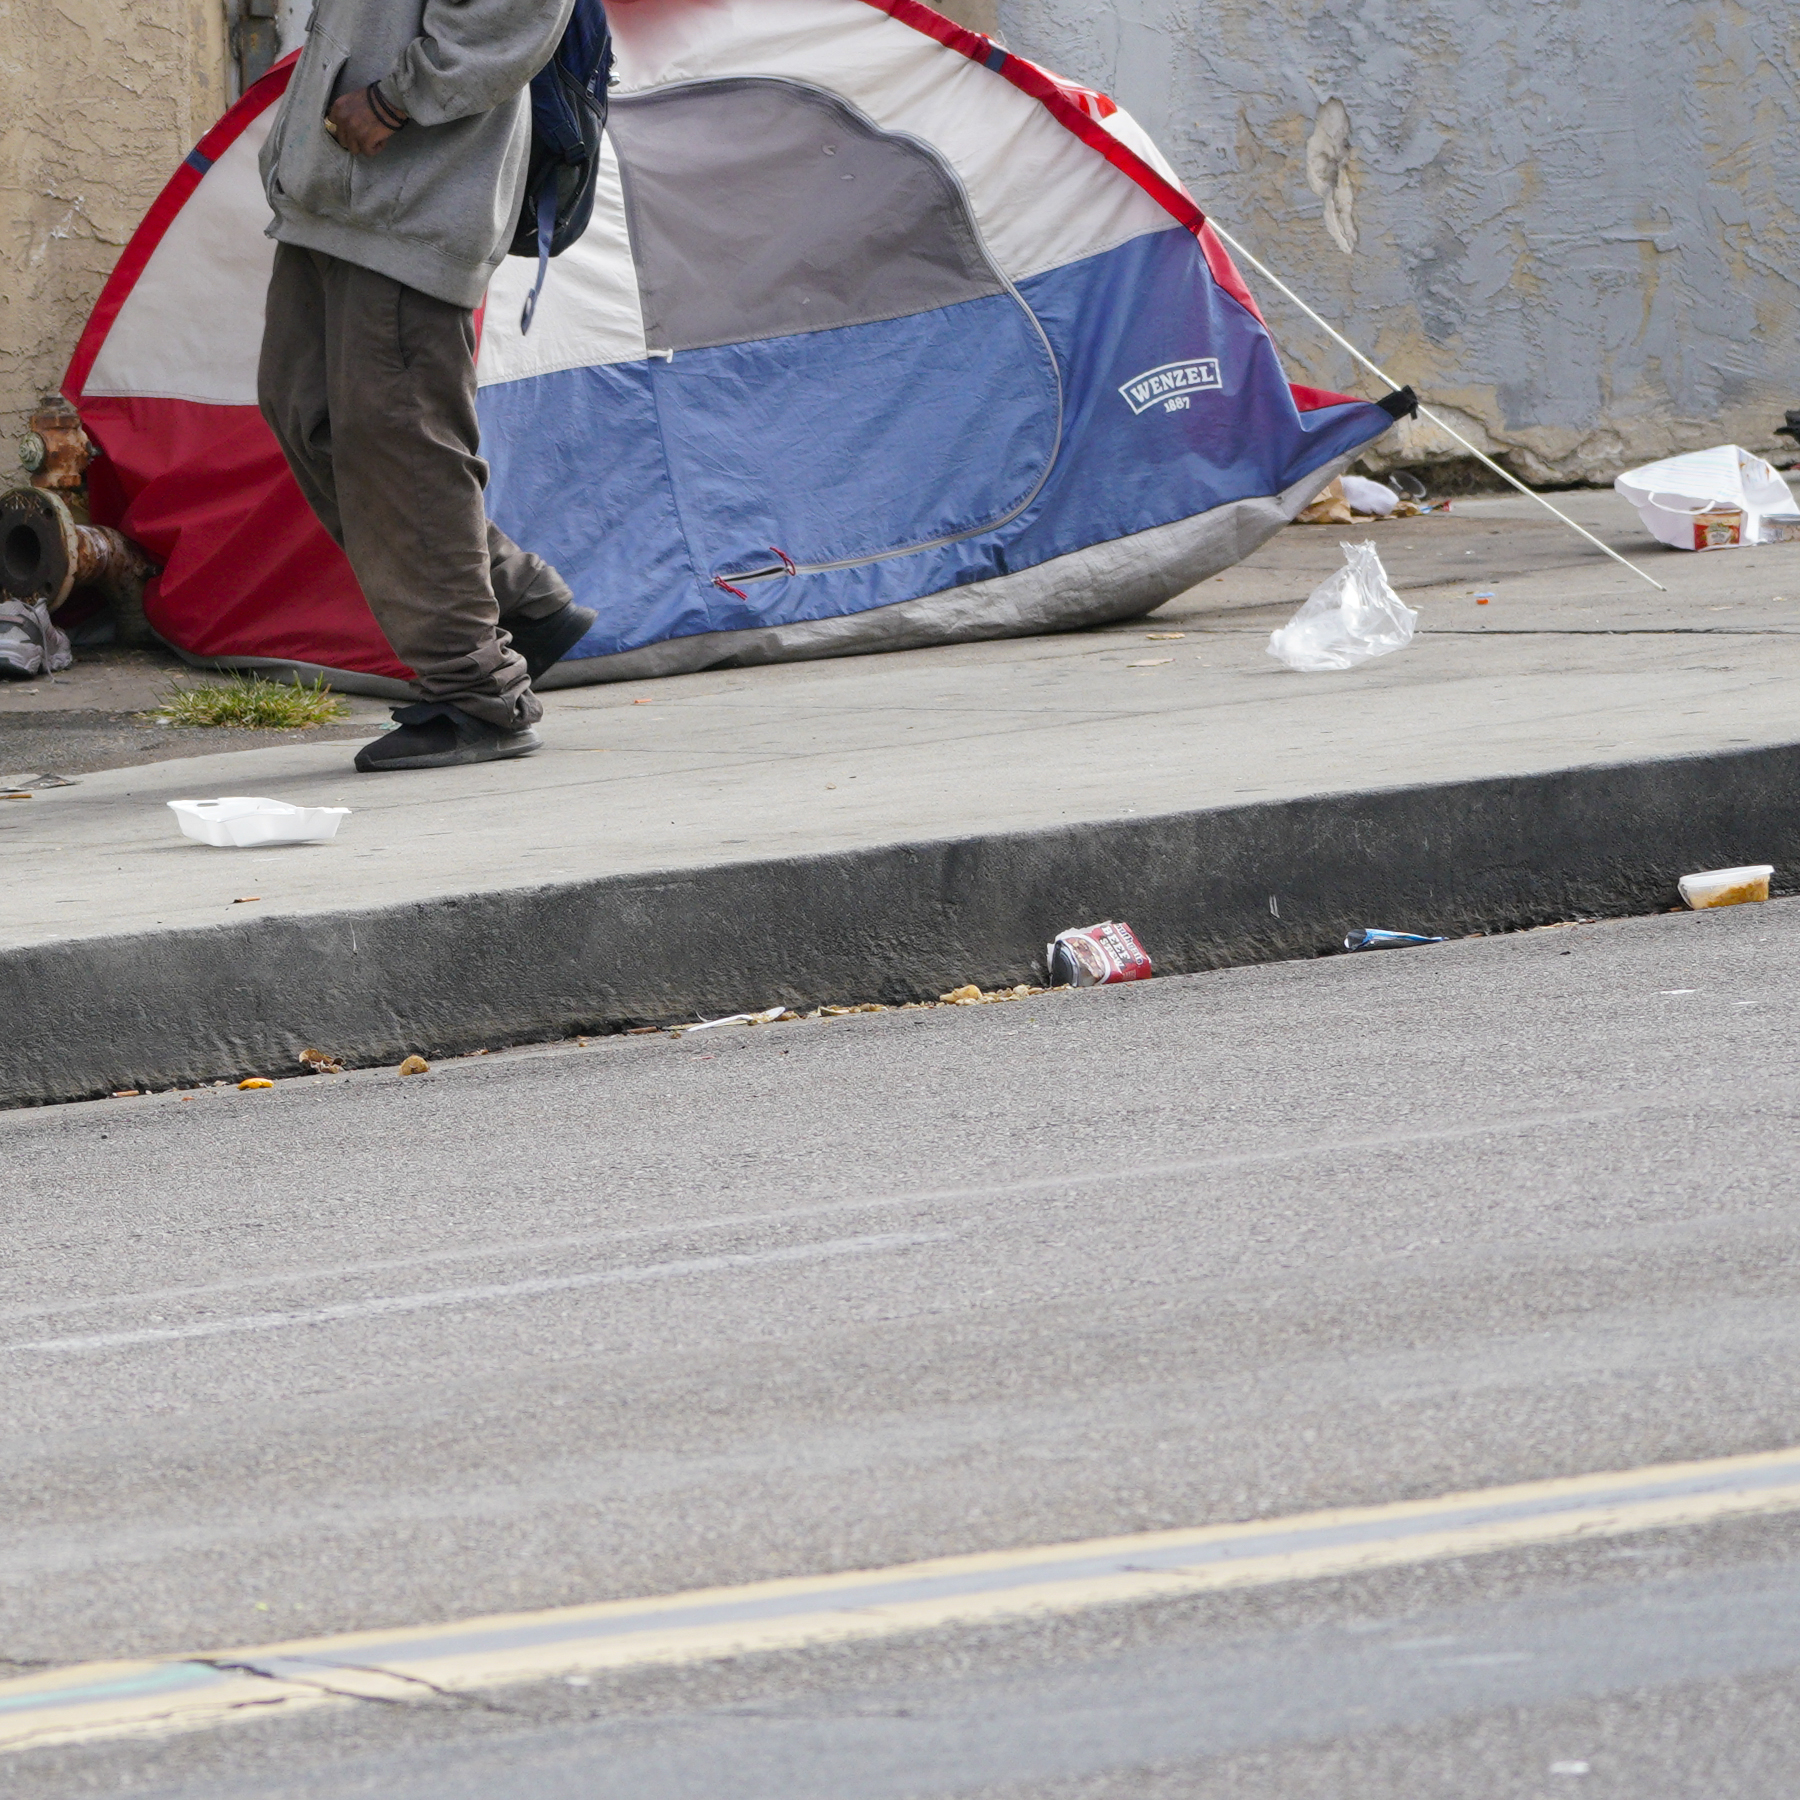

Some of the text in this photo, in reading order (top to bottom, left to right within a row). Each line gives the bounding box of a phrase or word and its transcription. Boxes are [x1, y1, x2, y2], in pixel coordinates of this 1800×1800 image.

[1130, 366, 1214, 403] WENZEL
[1164, 396, 1190, 413] 1887
[1100, 938, 1124, 968] STEW
[1101, 925, 1131, 960] BEEF
